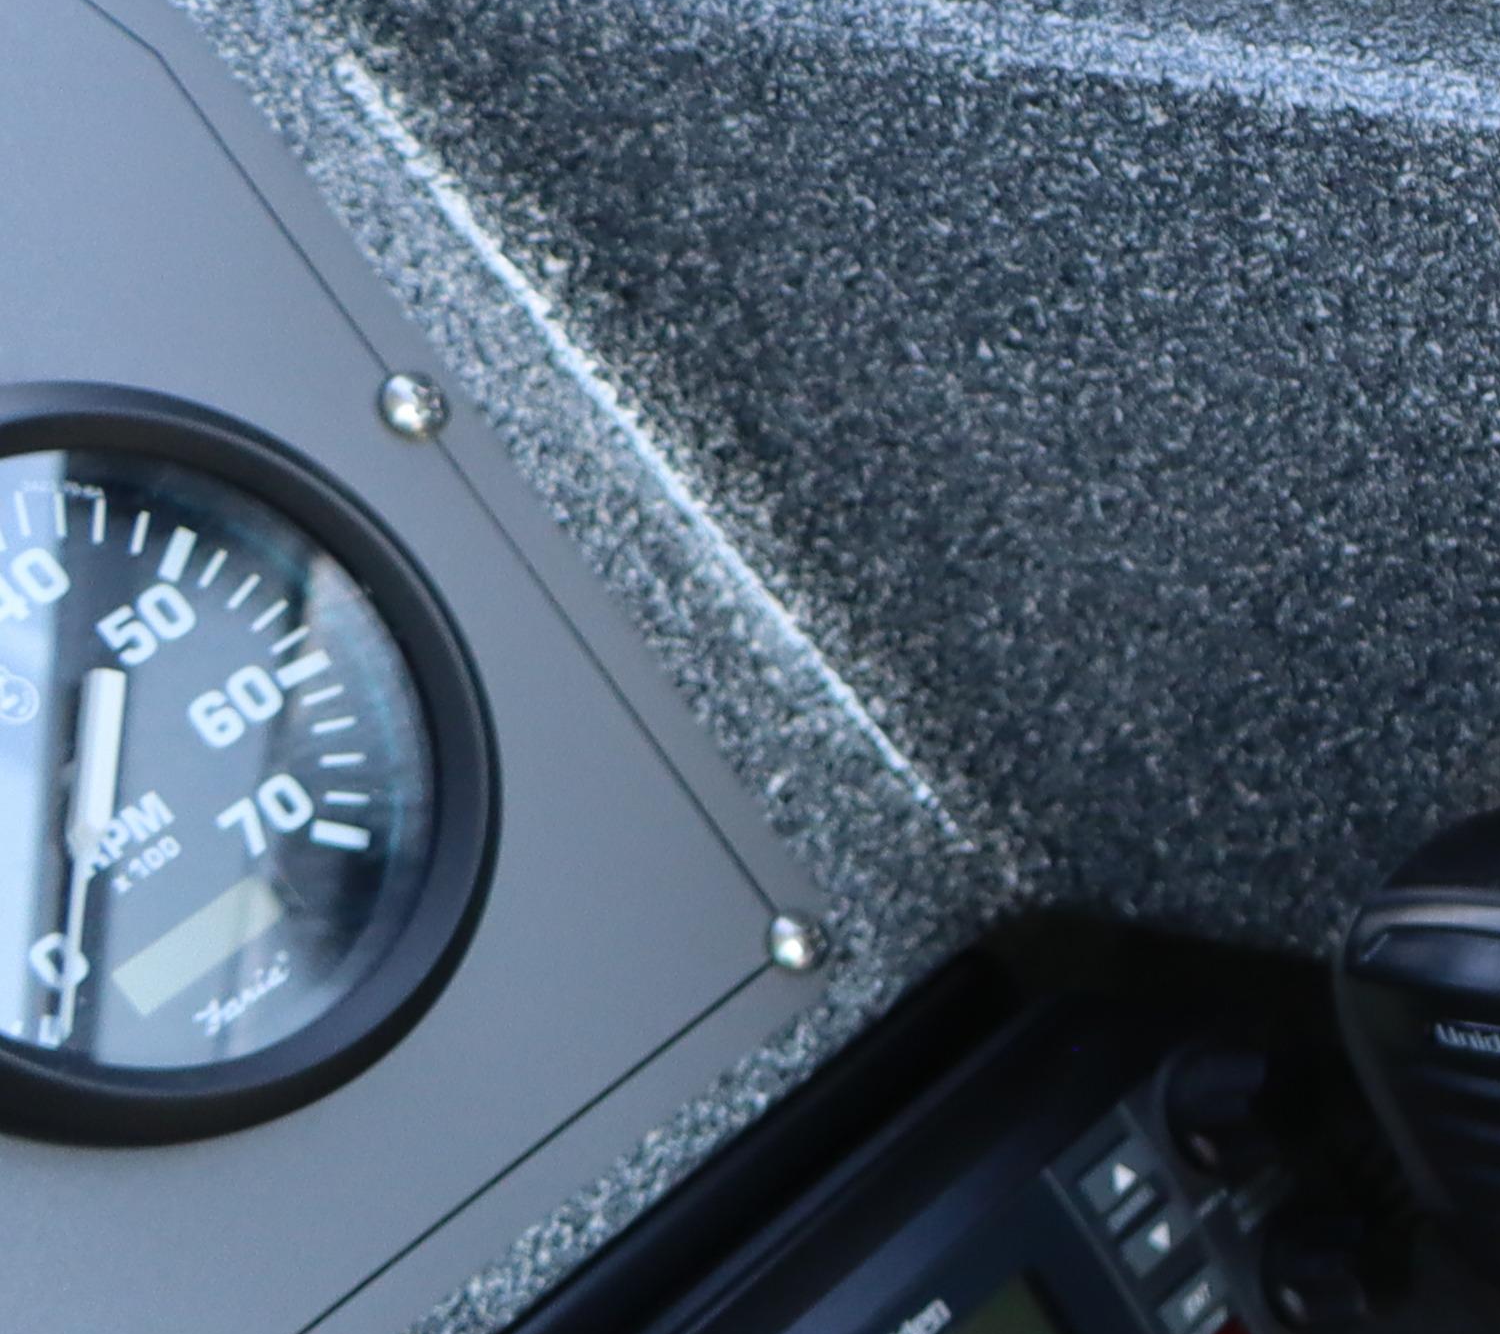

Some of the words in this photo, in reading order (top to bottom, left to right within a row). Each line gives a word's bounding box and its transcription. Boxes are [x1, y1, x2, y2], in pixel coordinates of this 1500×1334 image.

[96, 582, 197, 666] 50
[188, 665, 283, 749] 60
[216, 773, 314, 858] 70
